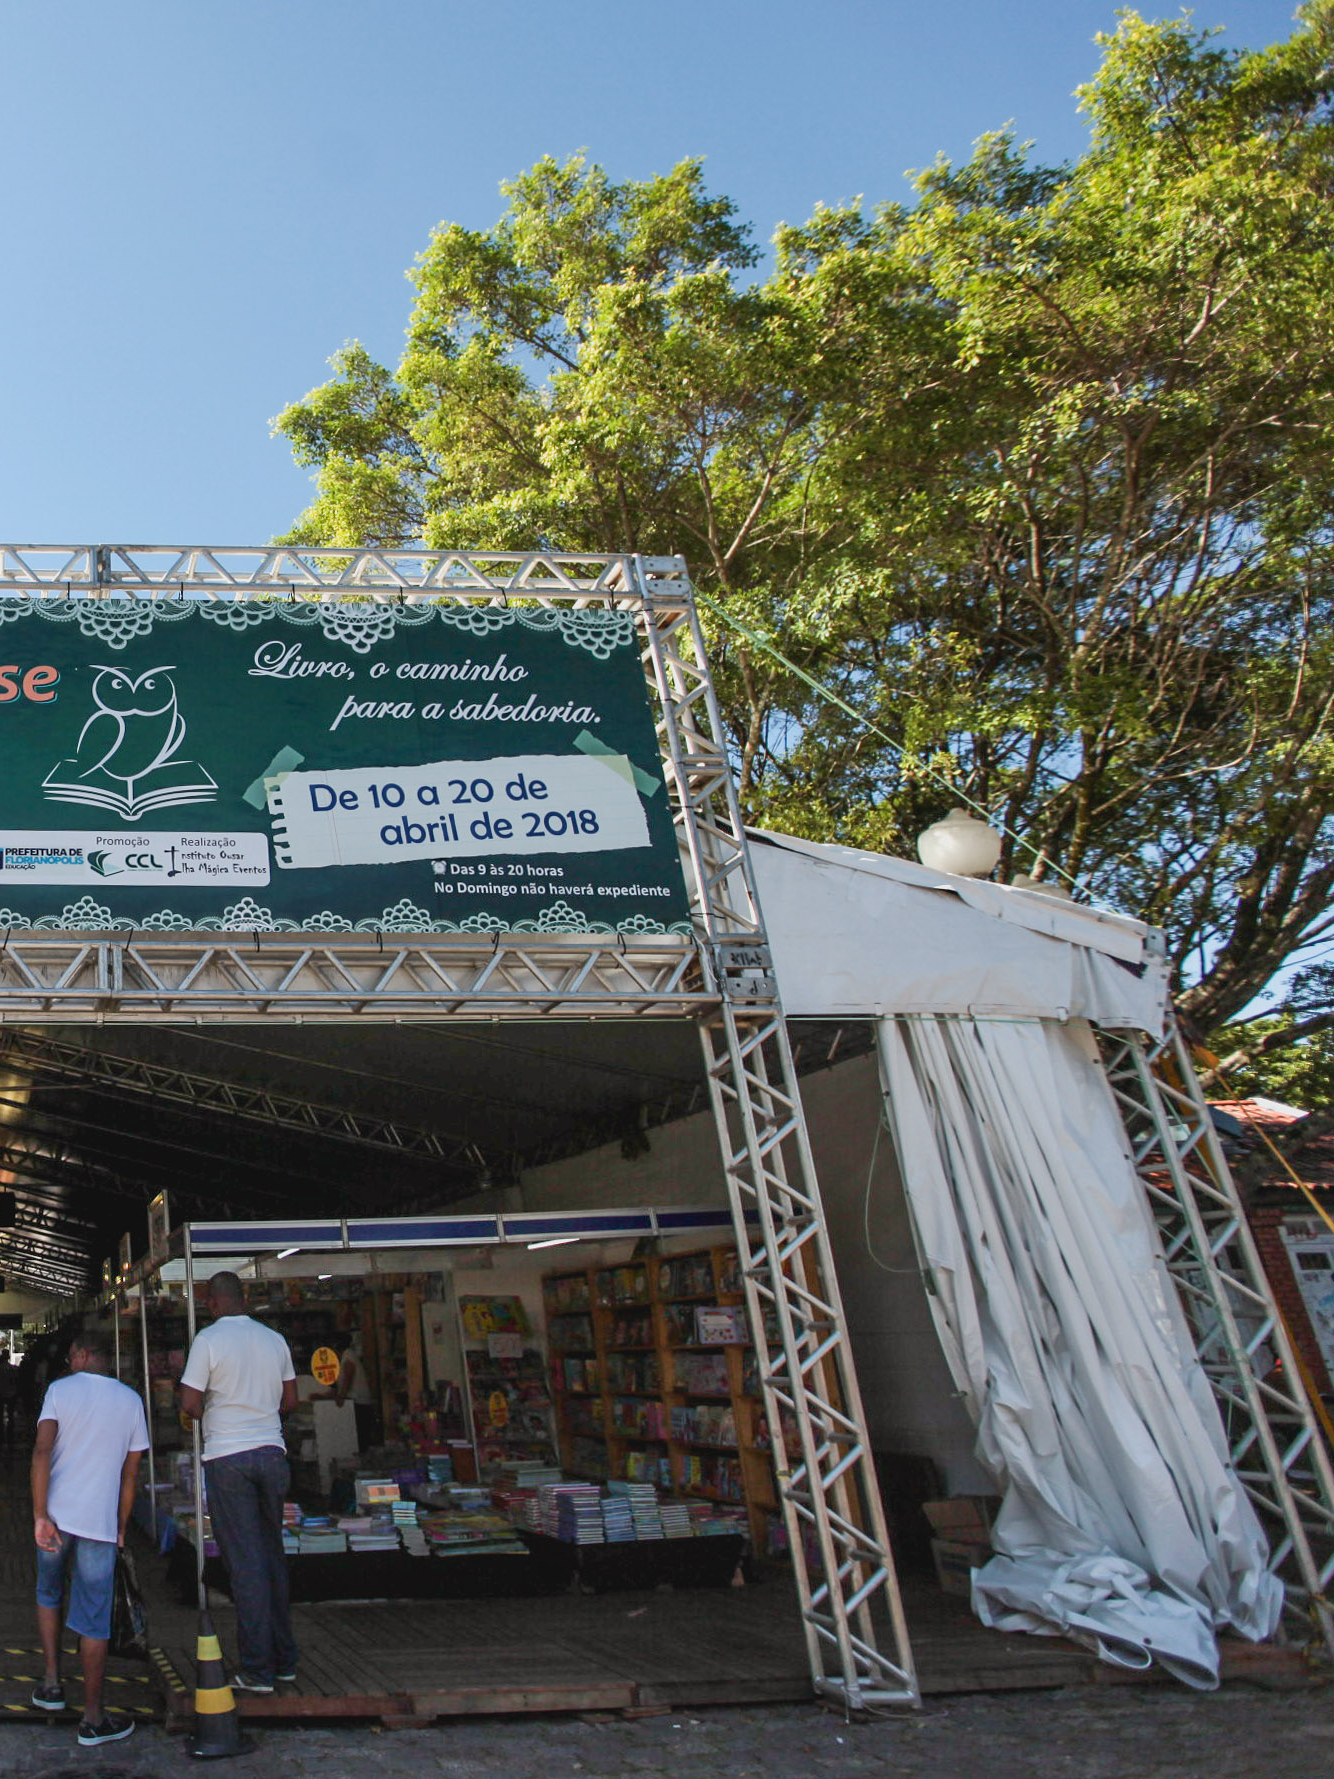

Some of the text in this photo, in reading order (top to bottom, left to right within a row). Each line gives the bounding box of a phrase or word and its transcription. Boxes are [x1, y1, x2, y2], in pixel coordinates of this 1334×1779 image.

[248, 640, 529, 682] Livro, o caminho
[329, 693, 602, 732] para a sabedoria.
[309, 773, 549, 813] De 10 a 20 de
[379, 808, 600, 846] abril de 2018
[95, 836, 150, 847] Promoção
[180, 837, 236, 848] Realização
[5, 848, 83, 857] PREFEITURA DE
[219, 850, 244, 860] Ousar
[125, 853, 164, 868] CCL
[199, 862, 229, 876] Mágica
[232, 863, 267, 874] Eventos
[449, 863, 564, 877] Das 9 às 20 horas
[434, 882, 671, 898] No Domingo não haverá expediente
